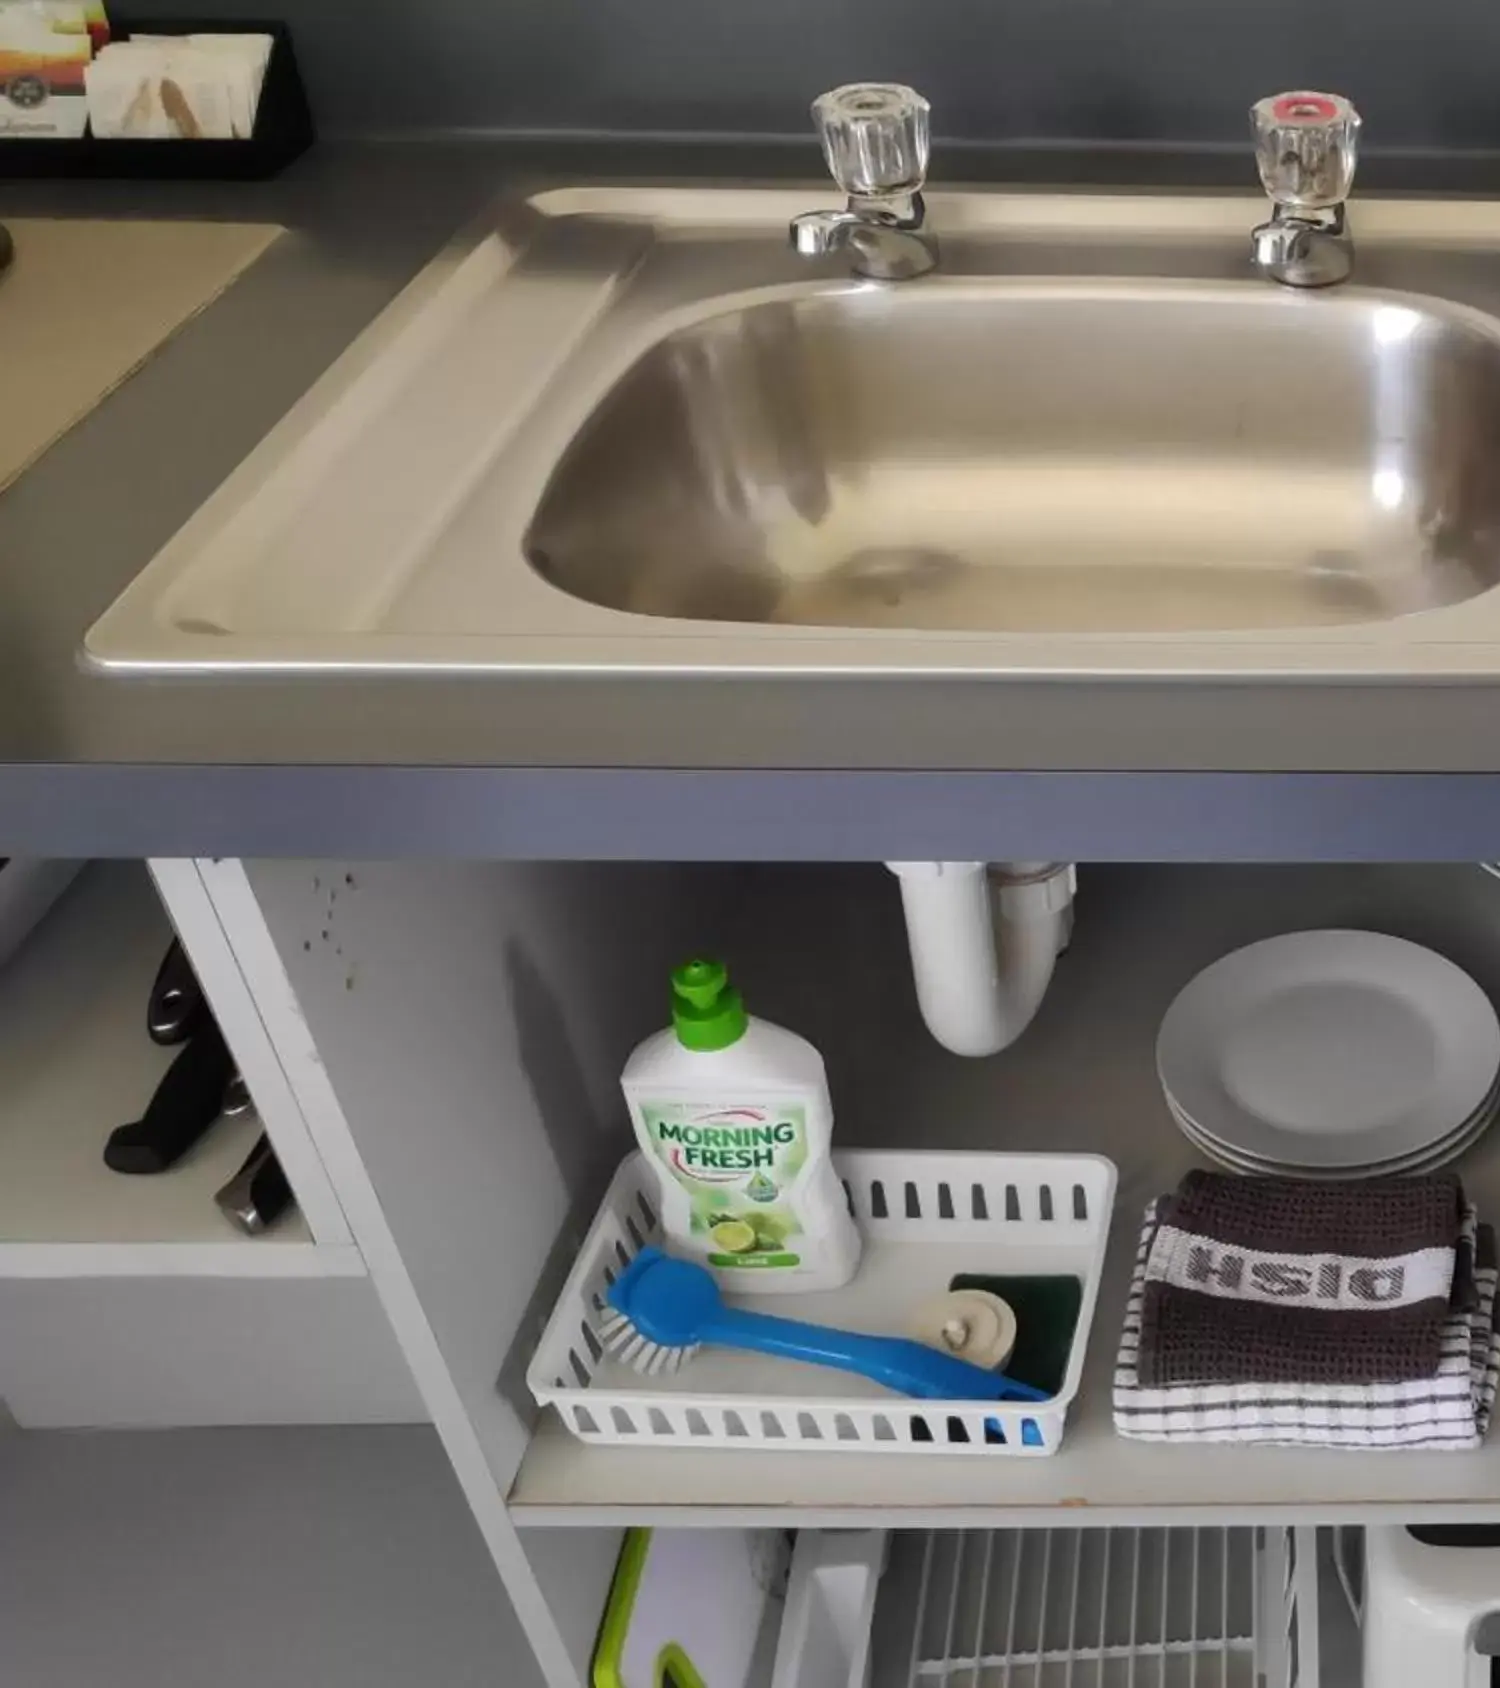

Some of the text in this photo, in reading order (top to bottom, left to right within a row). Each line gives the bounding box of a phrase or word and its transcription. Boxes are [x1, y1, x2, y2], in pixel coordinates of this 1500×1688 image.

[658, 1121, 794, 1147] MORNING
[685, 1147, 773, 1168] FRESH
[1185, 1246, 1406, 1301] DISH
